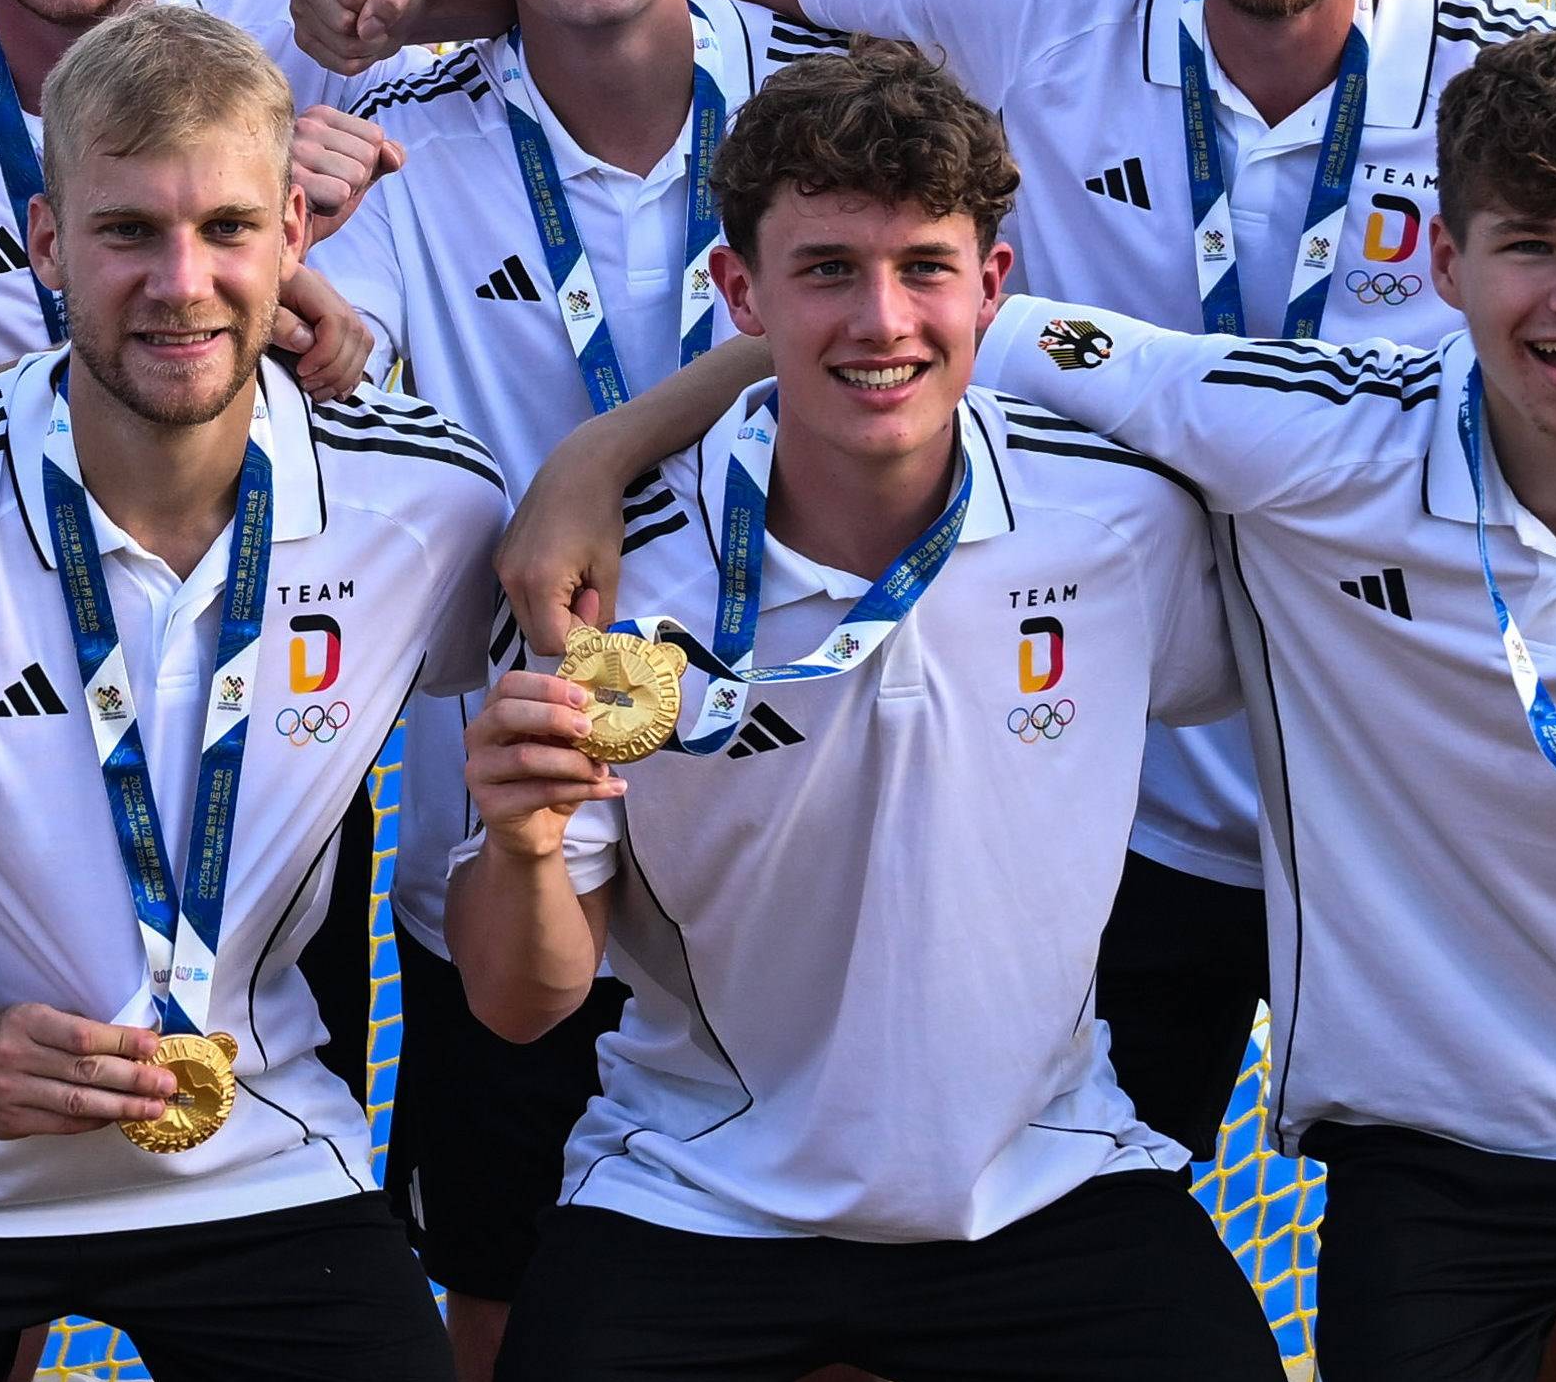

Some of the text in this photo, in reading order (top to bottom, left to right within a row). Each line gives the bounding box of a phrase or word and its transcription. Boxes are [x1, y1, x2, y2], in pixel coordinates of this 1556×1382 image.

[1364, 164, 1439, 188] TEAM
[278, 581, 354, 601] TEAM
[1010, 584, 1078, 606] TEAM
